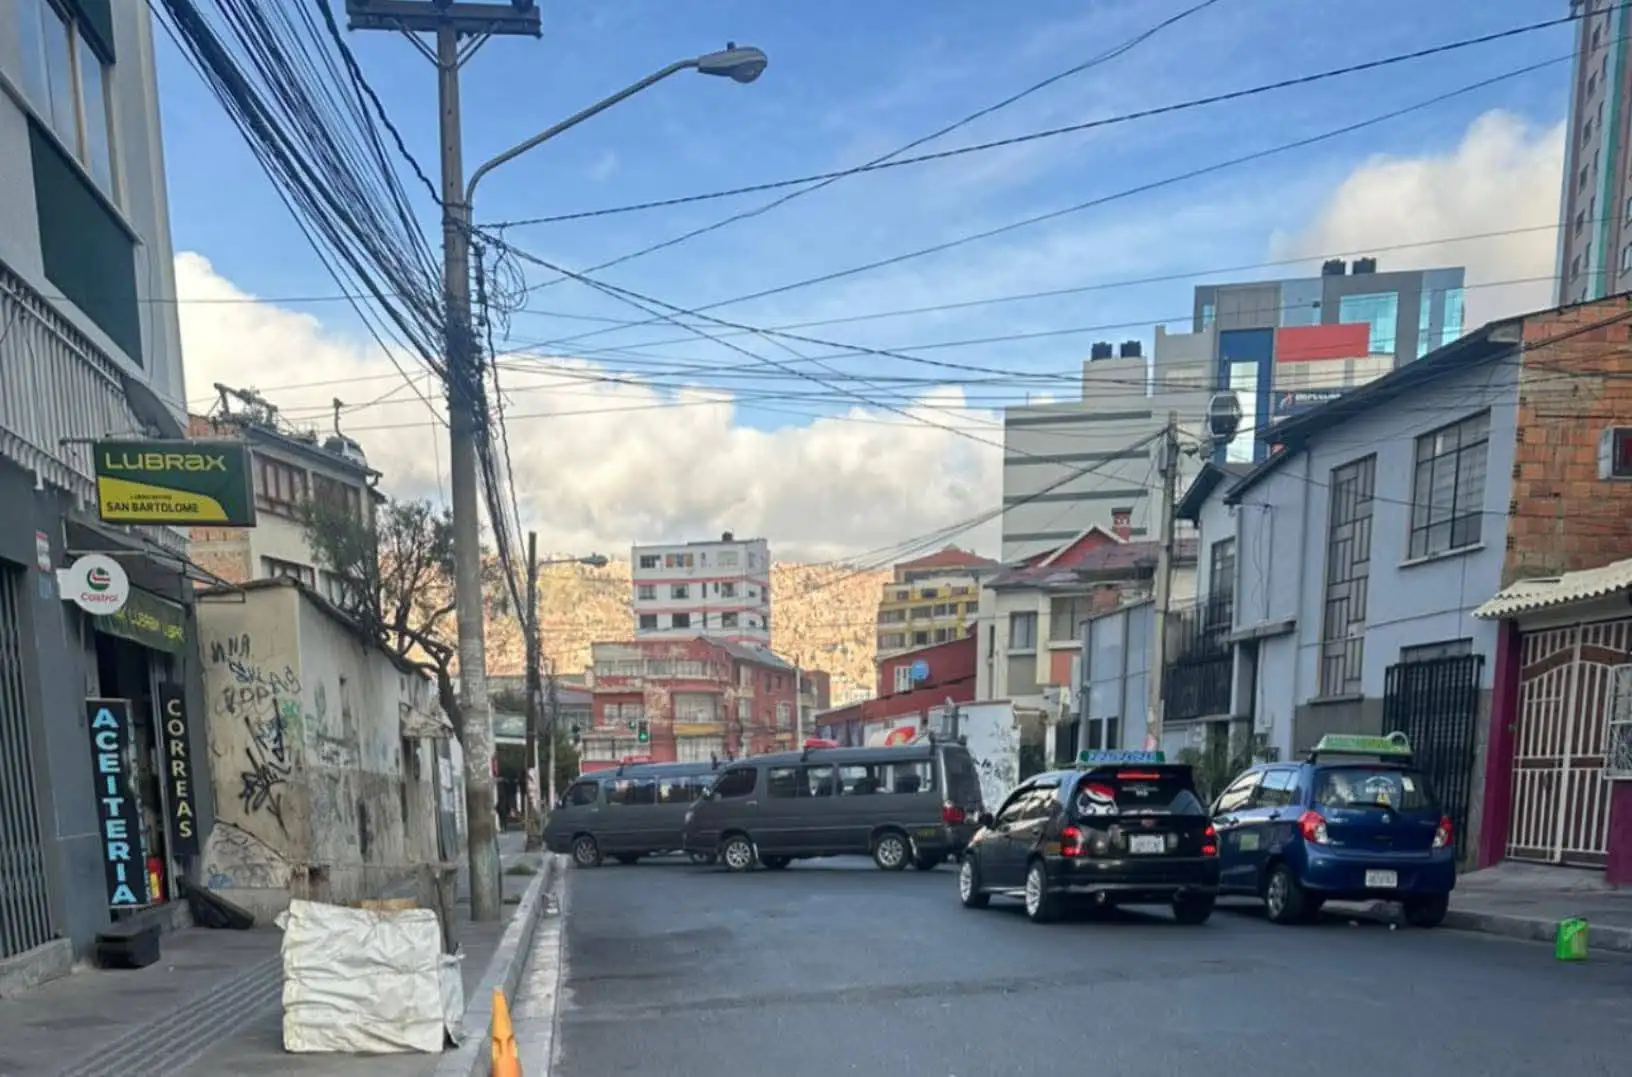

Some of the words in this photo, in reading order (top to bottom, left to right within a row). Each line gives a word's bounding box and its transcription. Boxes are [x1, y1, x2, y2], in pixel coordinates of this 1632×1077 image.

[106, 502, 129, 512] SAN
[131, 502, 199, 513] BARTOLOME
[80, 591, 119, 602] Castrol
[92, 707, 137, 904] ACEITERIA
[166, 699, 193, 838] CORREAS
